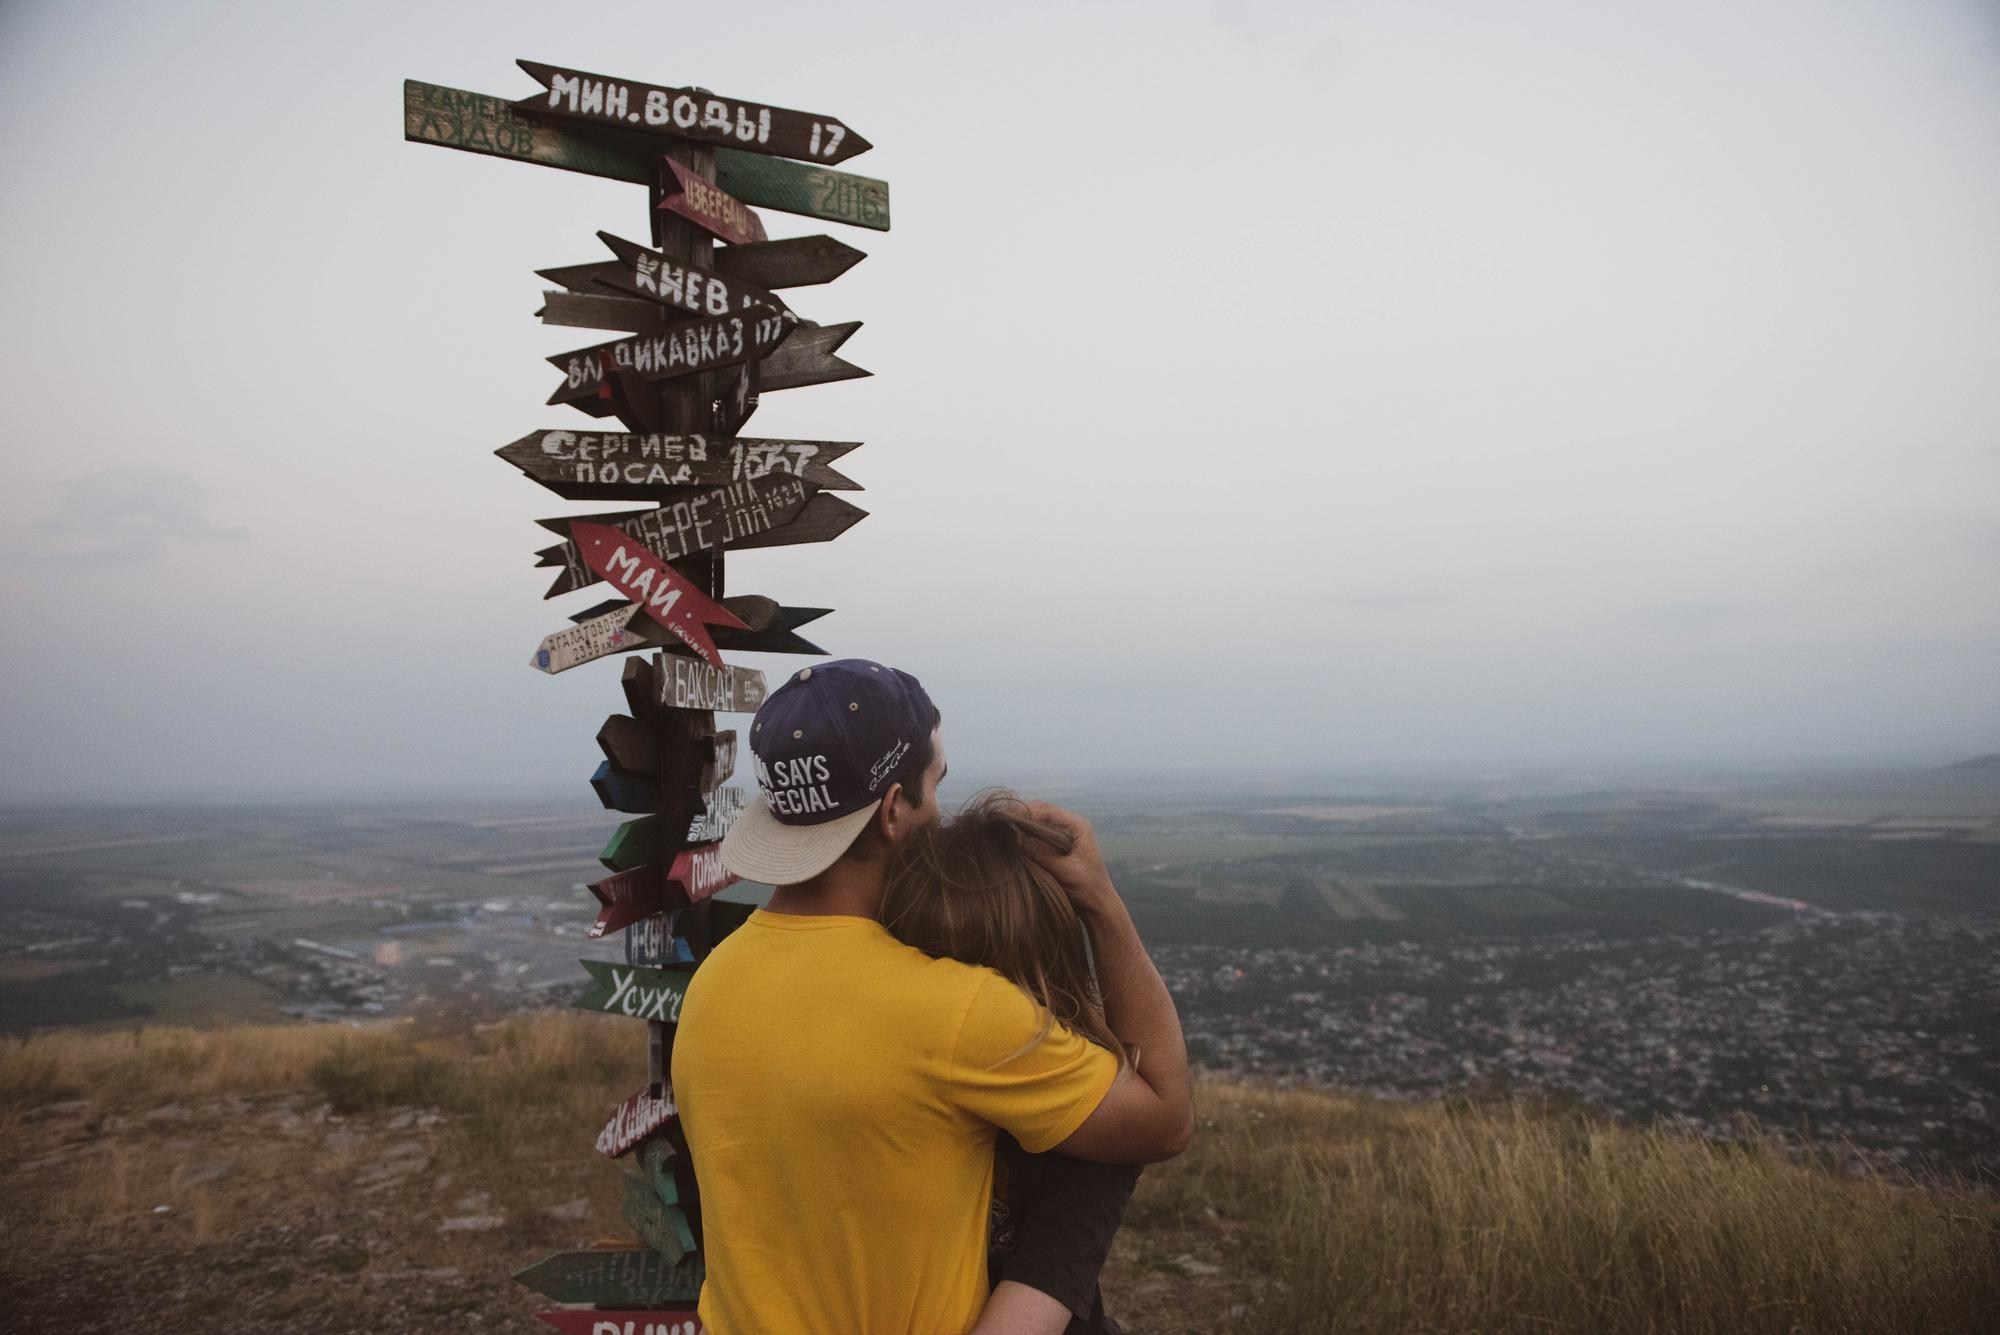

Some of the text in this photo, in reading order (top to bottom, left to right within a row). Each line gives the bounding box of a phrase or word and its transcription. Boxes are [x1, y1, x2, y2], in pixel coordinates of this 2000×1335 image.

[809, 122, 846, 156] 17
[635, 252, 730, 316] КИЕВ
[567, 317, 744, 390] ВЛДИКАВКАЗ
[540, 430, 708, 462] СЕРГИЕВ
[575, 461, 700, 486] ПОСАД
[675, 659, 736, 712] БАКСАН
[774, 754, 831, 788] SAYS
